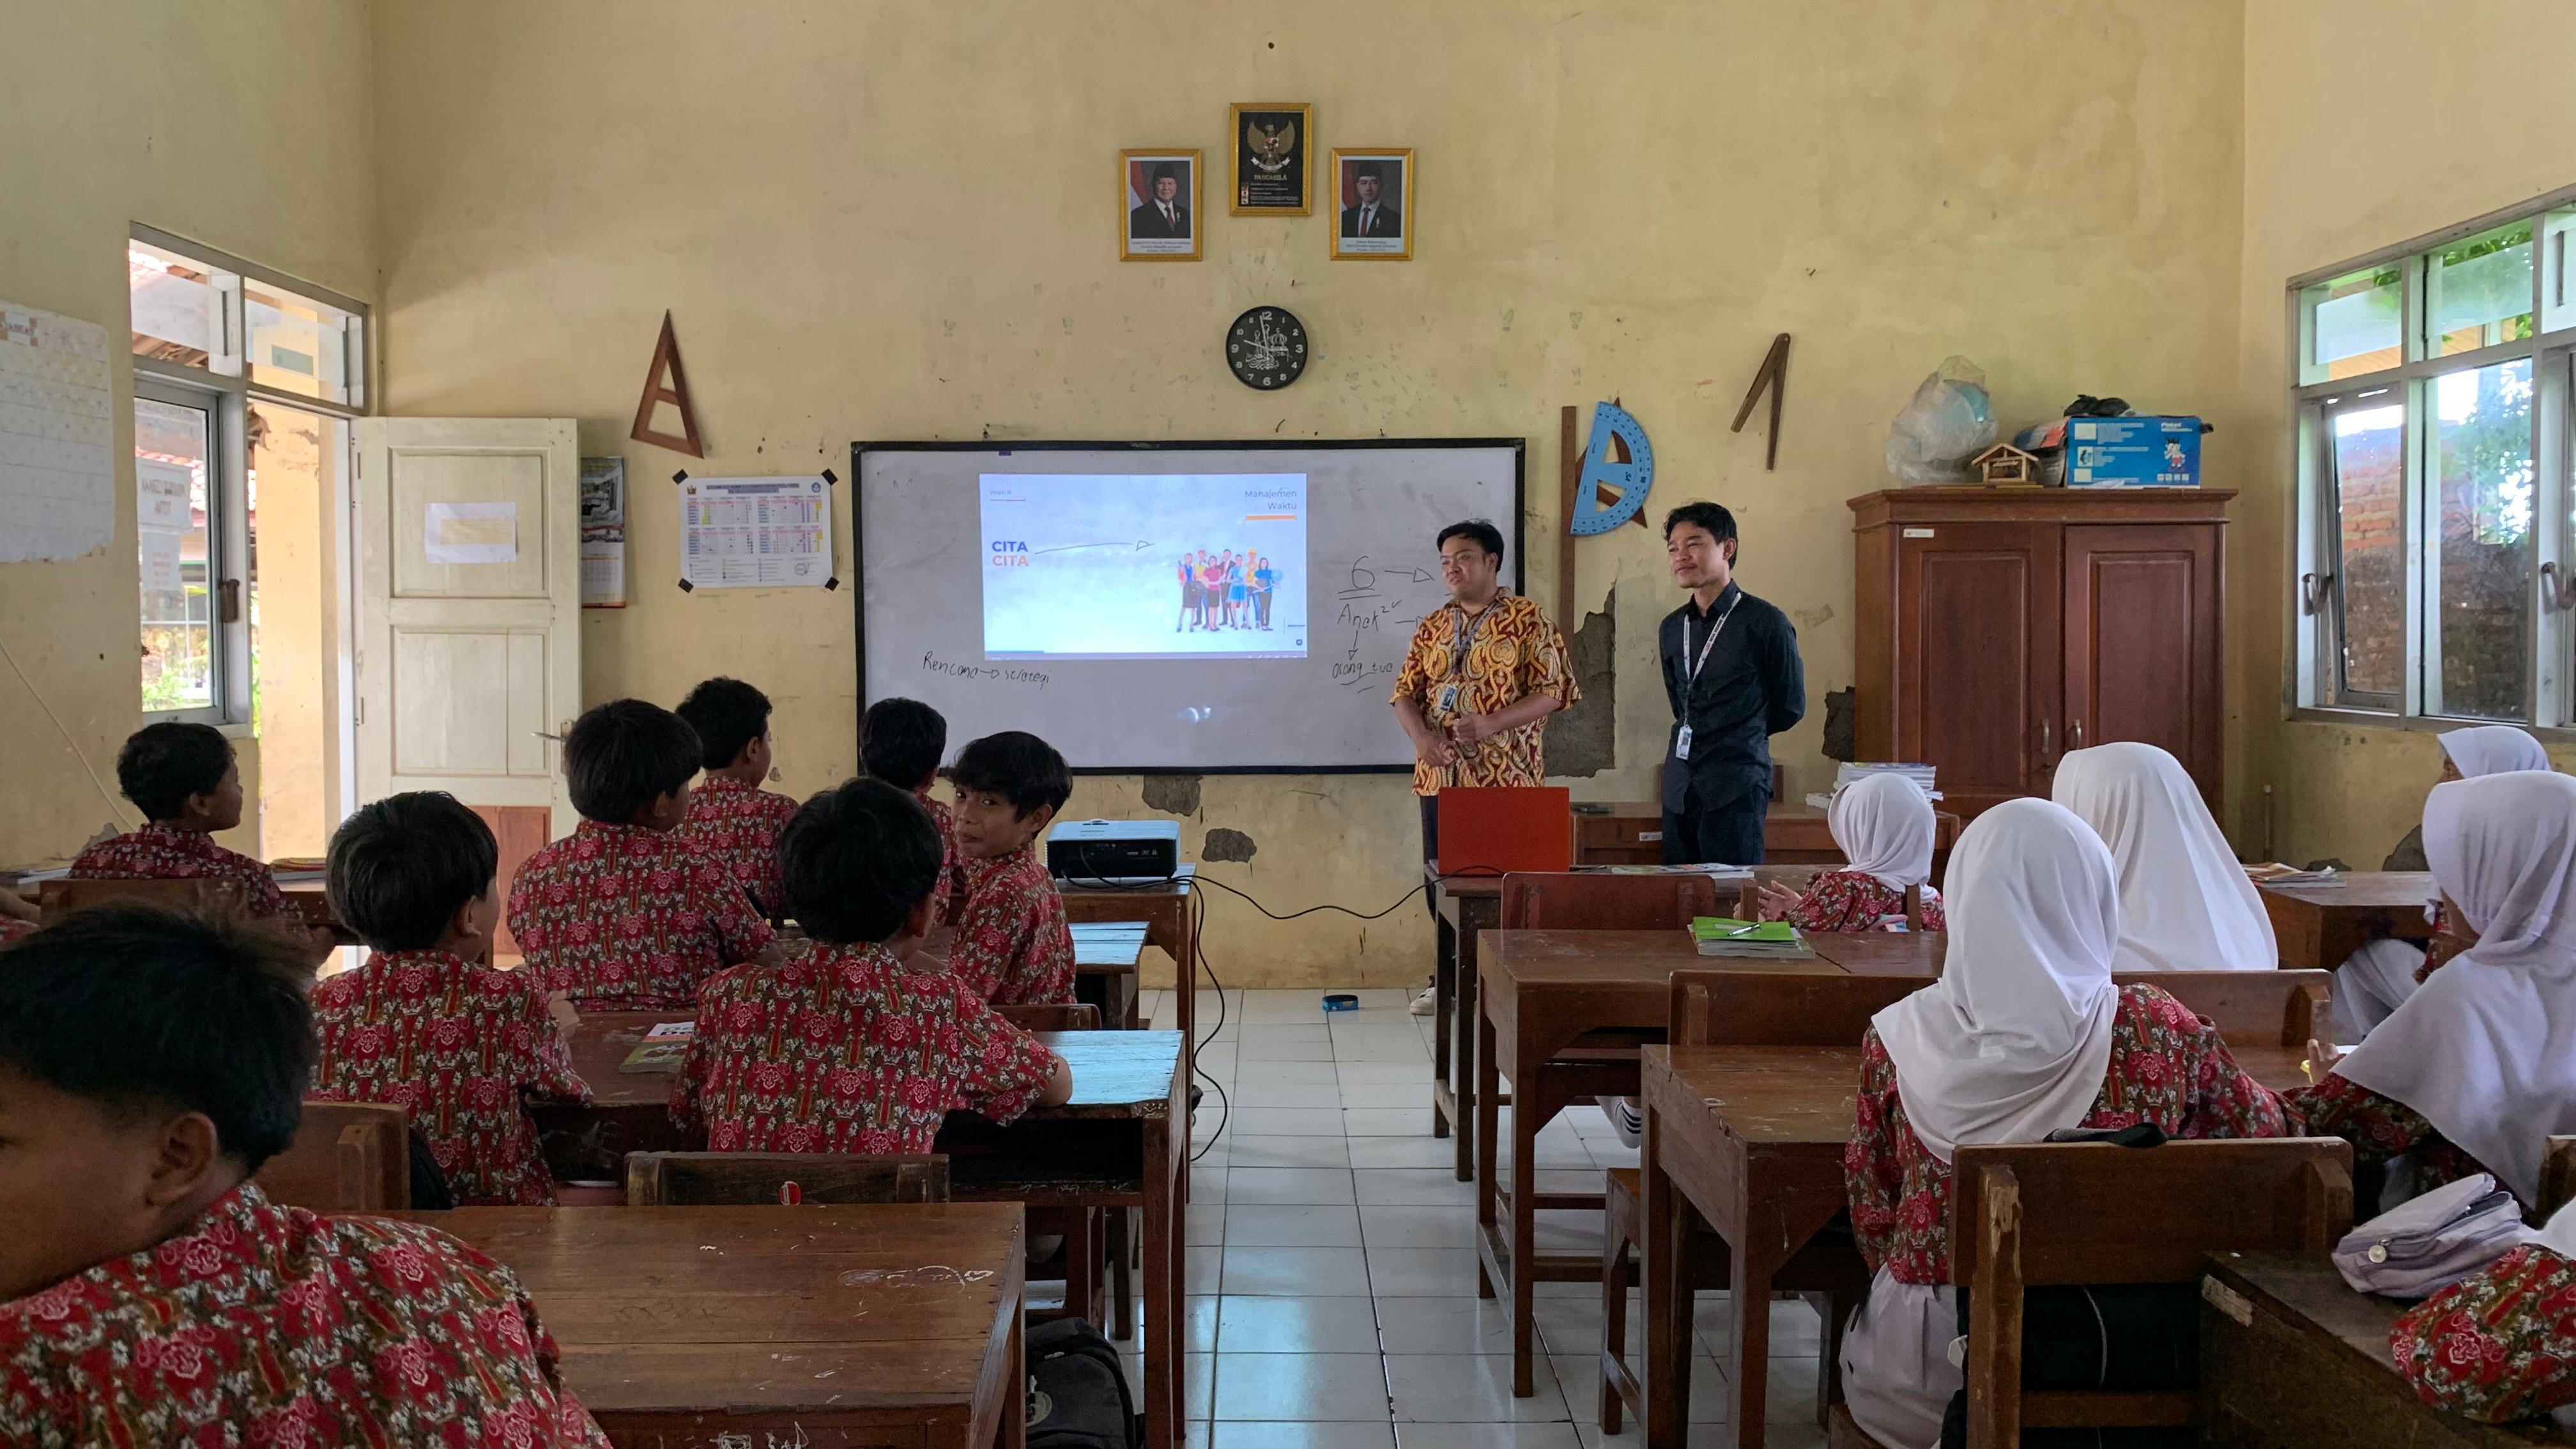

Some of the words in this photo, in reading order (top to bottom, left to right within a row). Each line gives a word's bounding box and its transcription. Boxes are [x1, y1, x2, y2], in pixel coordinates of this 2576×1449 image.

[1262, 311, 1273, 320] 12
[1230, 344, 1239, 353] 9
[1295, 344, 1303, 353] 3
[1262, 377, 1271, 386] 6
[1245, 489, 1297, 499] Manajemen
[992, 541, 1029, 553] CITA
[992, 555, 1029, 567] CITA
[1351, 556, 1375, 589] 6
